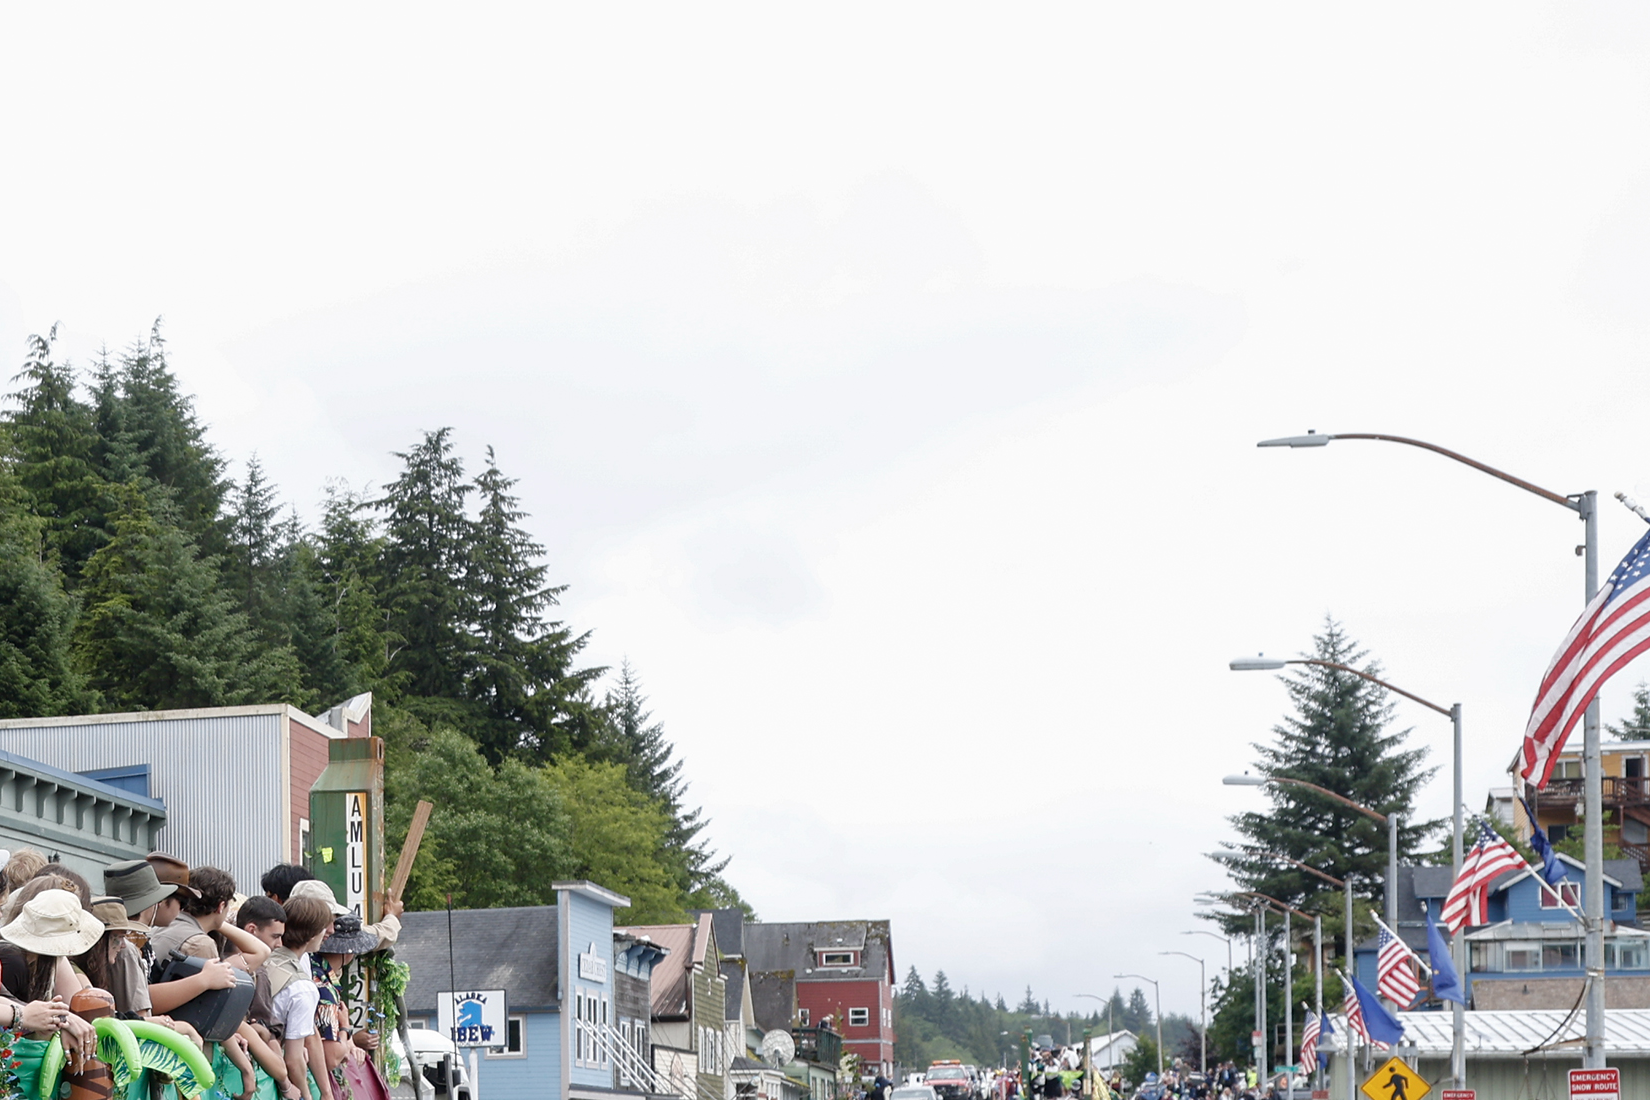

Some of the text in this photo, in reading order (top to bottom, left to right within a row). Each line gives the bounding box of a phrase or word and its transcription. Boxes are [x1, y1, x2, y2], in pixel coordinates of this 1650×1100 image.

[350, 794, 364, 894] AMLU
[454, 992, 488, 1005] ALASKA
[450, 1025, 493, 1042] IBEW
[1571, 1073, 1616, 1082] EMERGENCY
[1571, 1082, 1617, 1091] SNOW ROUTE
